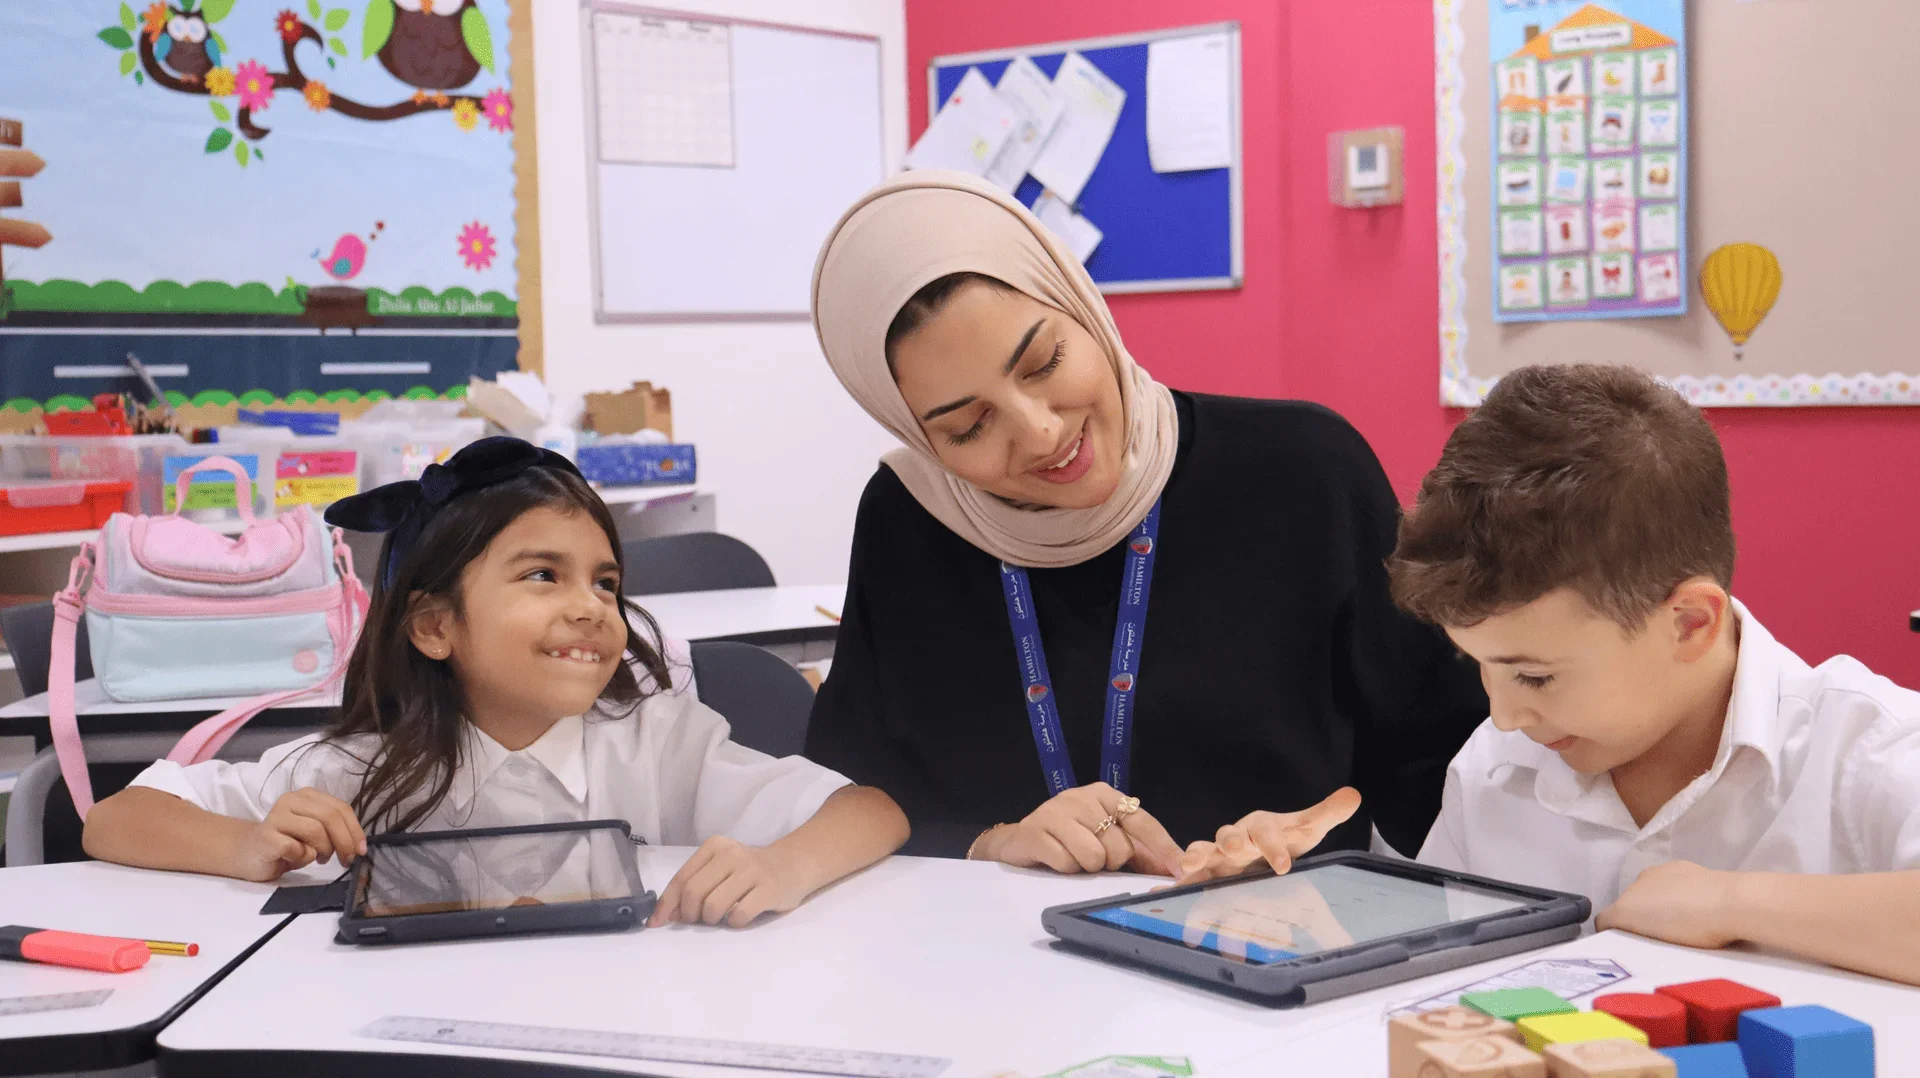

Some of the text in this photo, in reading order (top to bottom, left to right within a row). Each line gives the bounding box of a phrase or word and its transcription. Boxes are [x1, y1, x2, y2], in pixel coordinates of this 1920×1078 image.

[1132, 556, 1146, 606] HAMILTON
[1021, 636, 1037, 683] HAMILTON
[1122, 649, 1134, 671] مدرسة
[1115, 694, 1126, 746] HAMILTON
